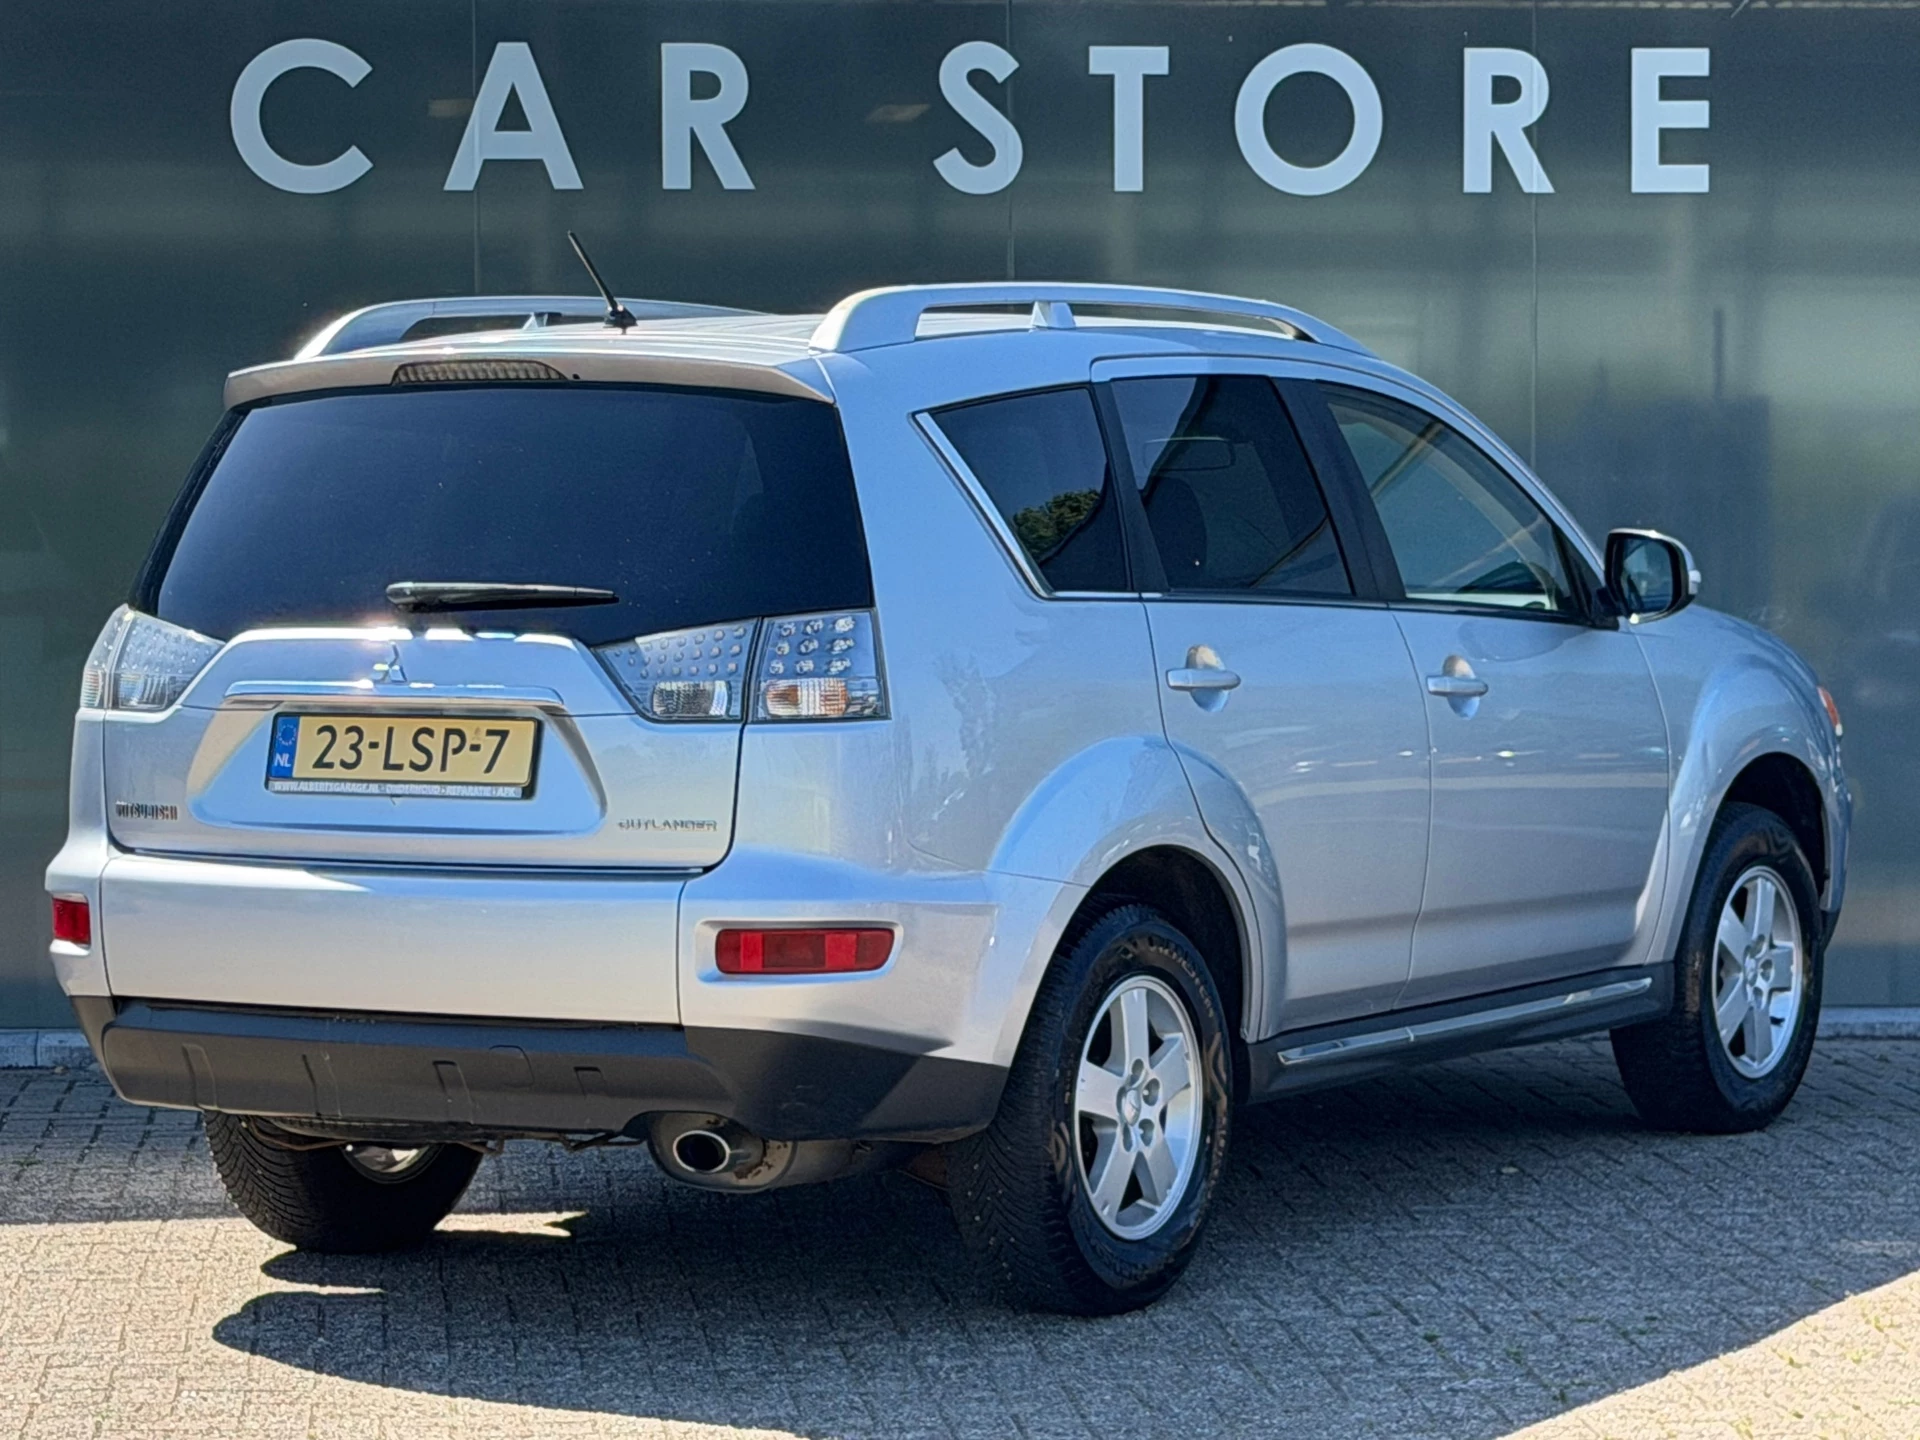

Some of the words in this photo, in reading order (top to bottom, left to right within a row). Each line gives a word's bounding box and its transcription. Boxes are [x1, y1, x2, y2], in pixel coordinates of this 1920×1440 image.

[230, 38, 756, 194] CAR
[933, 40, 1710, 196] STORE
[273, 753, 292, 768] NL
[311, 724, 511, 774] 23-LSP-7
